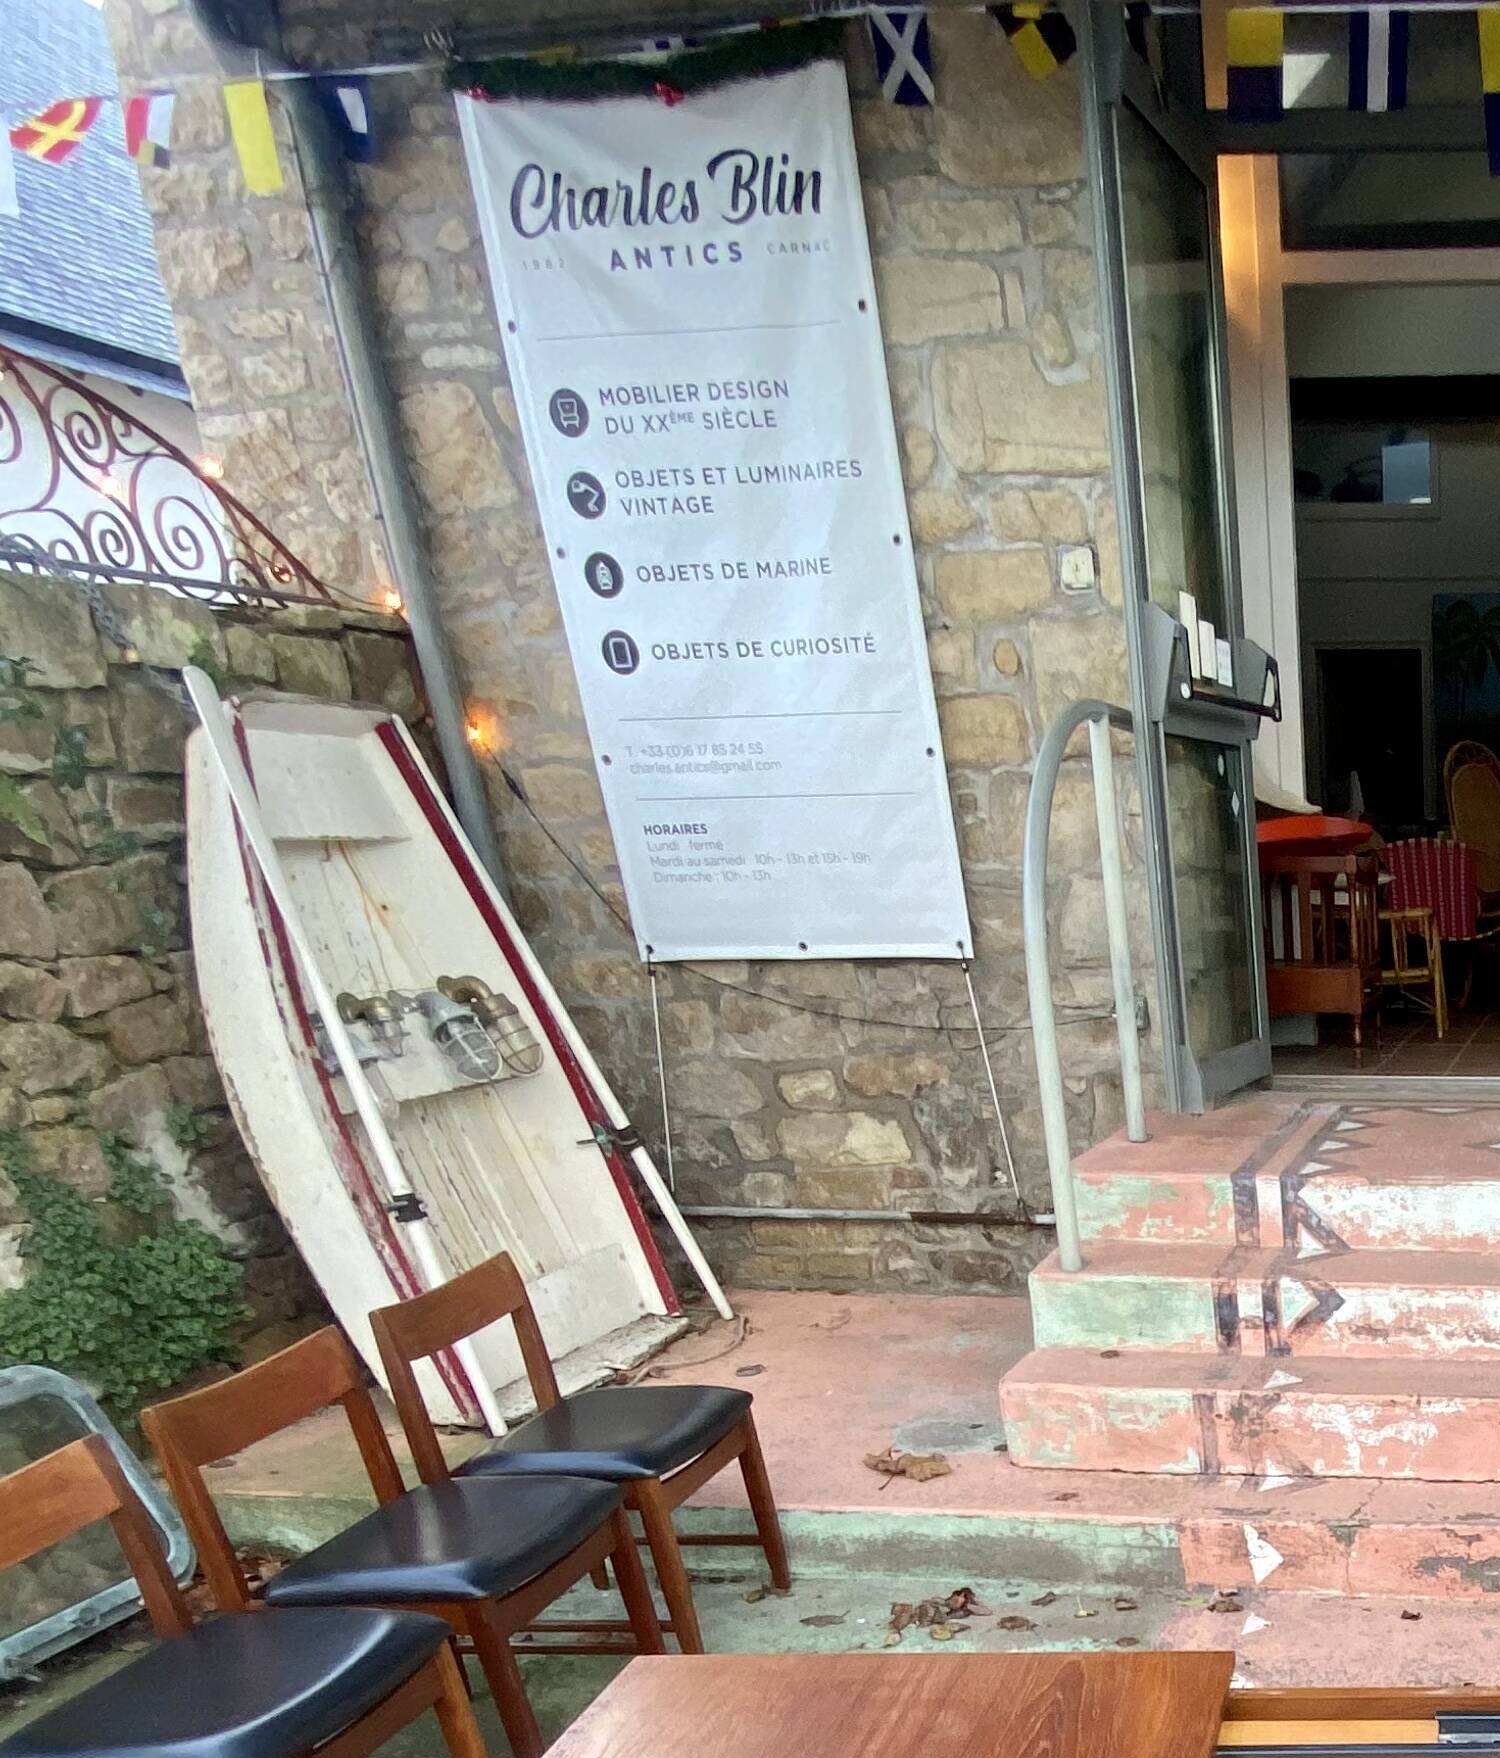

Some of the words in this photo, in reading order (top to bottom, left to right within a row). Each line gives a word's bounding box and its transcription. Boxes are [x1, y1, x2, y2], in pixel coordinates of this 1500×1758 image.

[510, 163, 700, 239] Charles
[706, 148, 822, 225] Blin
[610, 241, 744, 271] ANTICS
[767, 239, 831, 256] CARNAC
[598, 384, 700, 407] MOBILIER
[707, 380, 789, 403] DESIGN
[604, 415, 634, 436] DU
[702, 406, 778, 430] SIÈCLE
[615, 467, 696, 489] OBJETS
[702, 466, 727, 486] ET
[735, 460, 863, 485] LUMINAIRES
[620, 495, 715, 516] VINTAGE
[636, 564, 715, 583] OBJETS
[720, 562, 749, 581] DE
[755, 557, 832, 579] MARINE
[651, 642, 729, 661] OBJETS
[736, 640, 764, 659] DE
[770, 632, 877, 658] CURIOSITÉ
[697, 744, 708, 756] 17
[643, 823, 708, 837] HORAIRES
[646, 840, 681, 852] Lundi
[650, 855, 684, 867] Mardi
[687, 857, 701, 867] au
[704, 855, 746, 867] samedi
[808, 852, 820, 865] et
[653, 870, 713, 883] Dimanche
